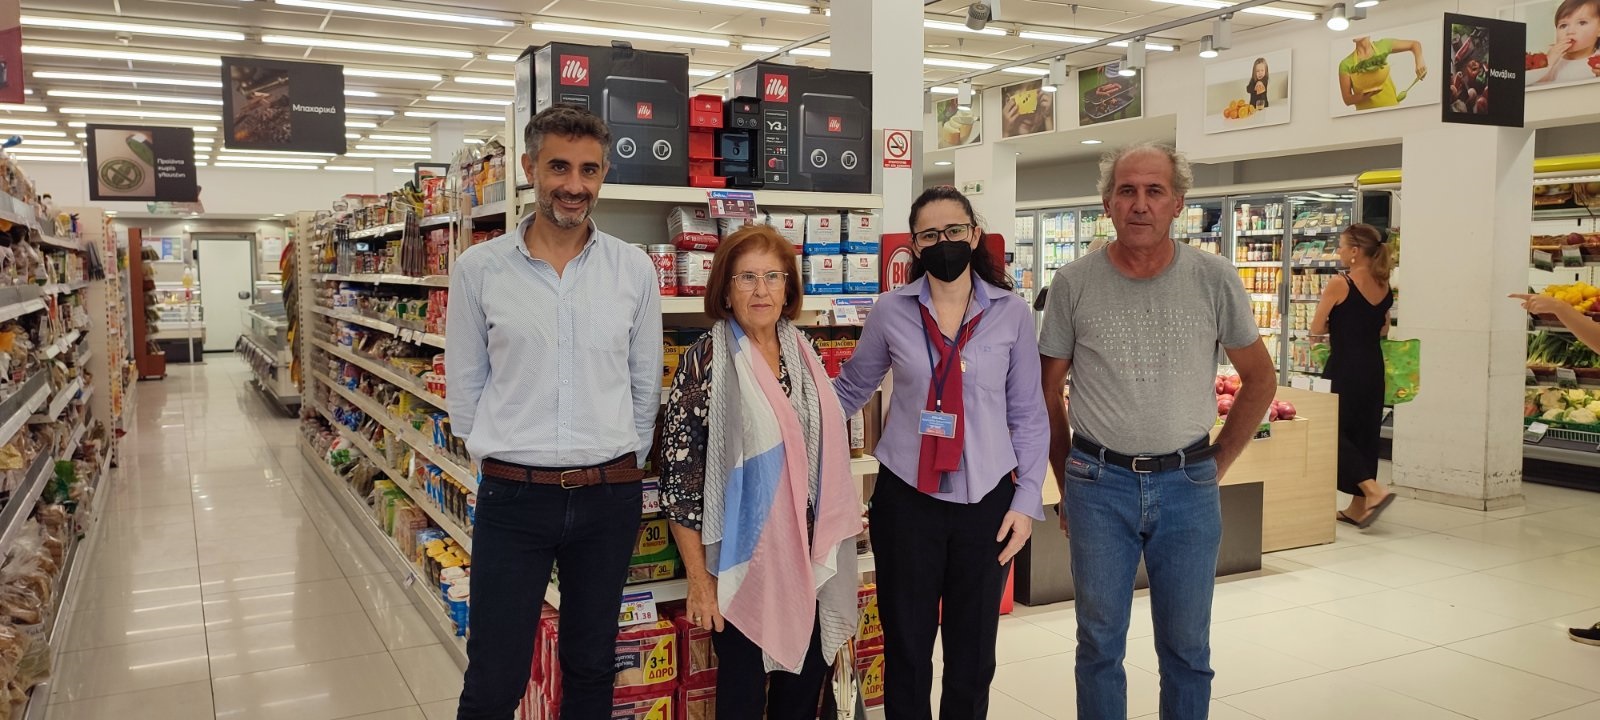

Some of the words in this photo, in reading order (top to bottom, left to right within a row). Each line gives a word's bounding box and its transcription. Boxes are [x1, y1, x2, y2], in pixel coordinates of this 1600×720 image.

[562, 60, 587, 83] illy
[766, 78, 787, 99] illy
[292, 103, 337, 115] Μπαχαρικά
[638, 105, 651, 116] illy
[828, 119, 841, 130] illy
[645, 526, 660, 541] 30
[650, 640, 673, 669] 3+1
[649, 667, 674, 680] ΔΩΡΟ
[865, 682, 884, 695] ΔΩΡΟ
